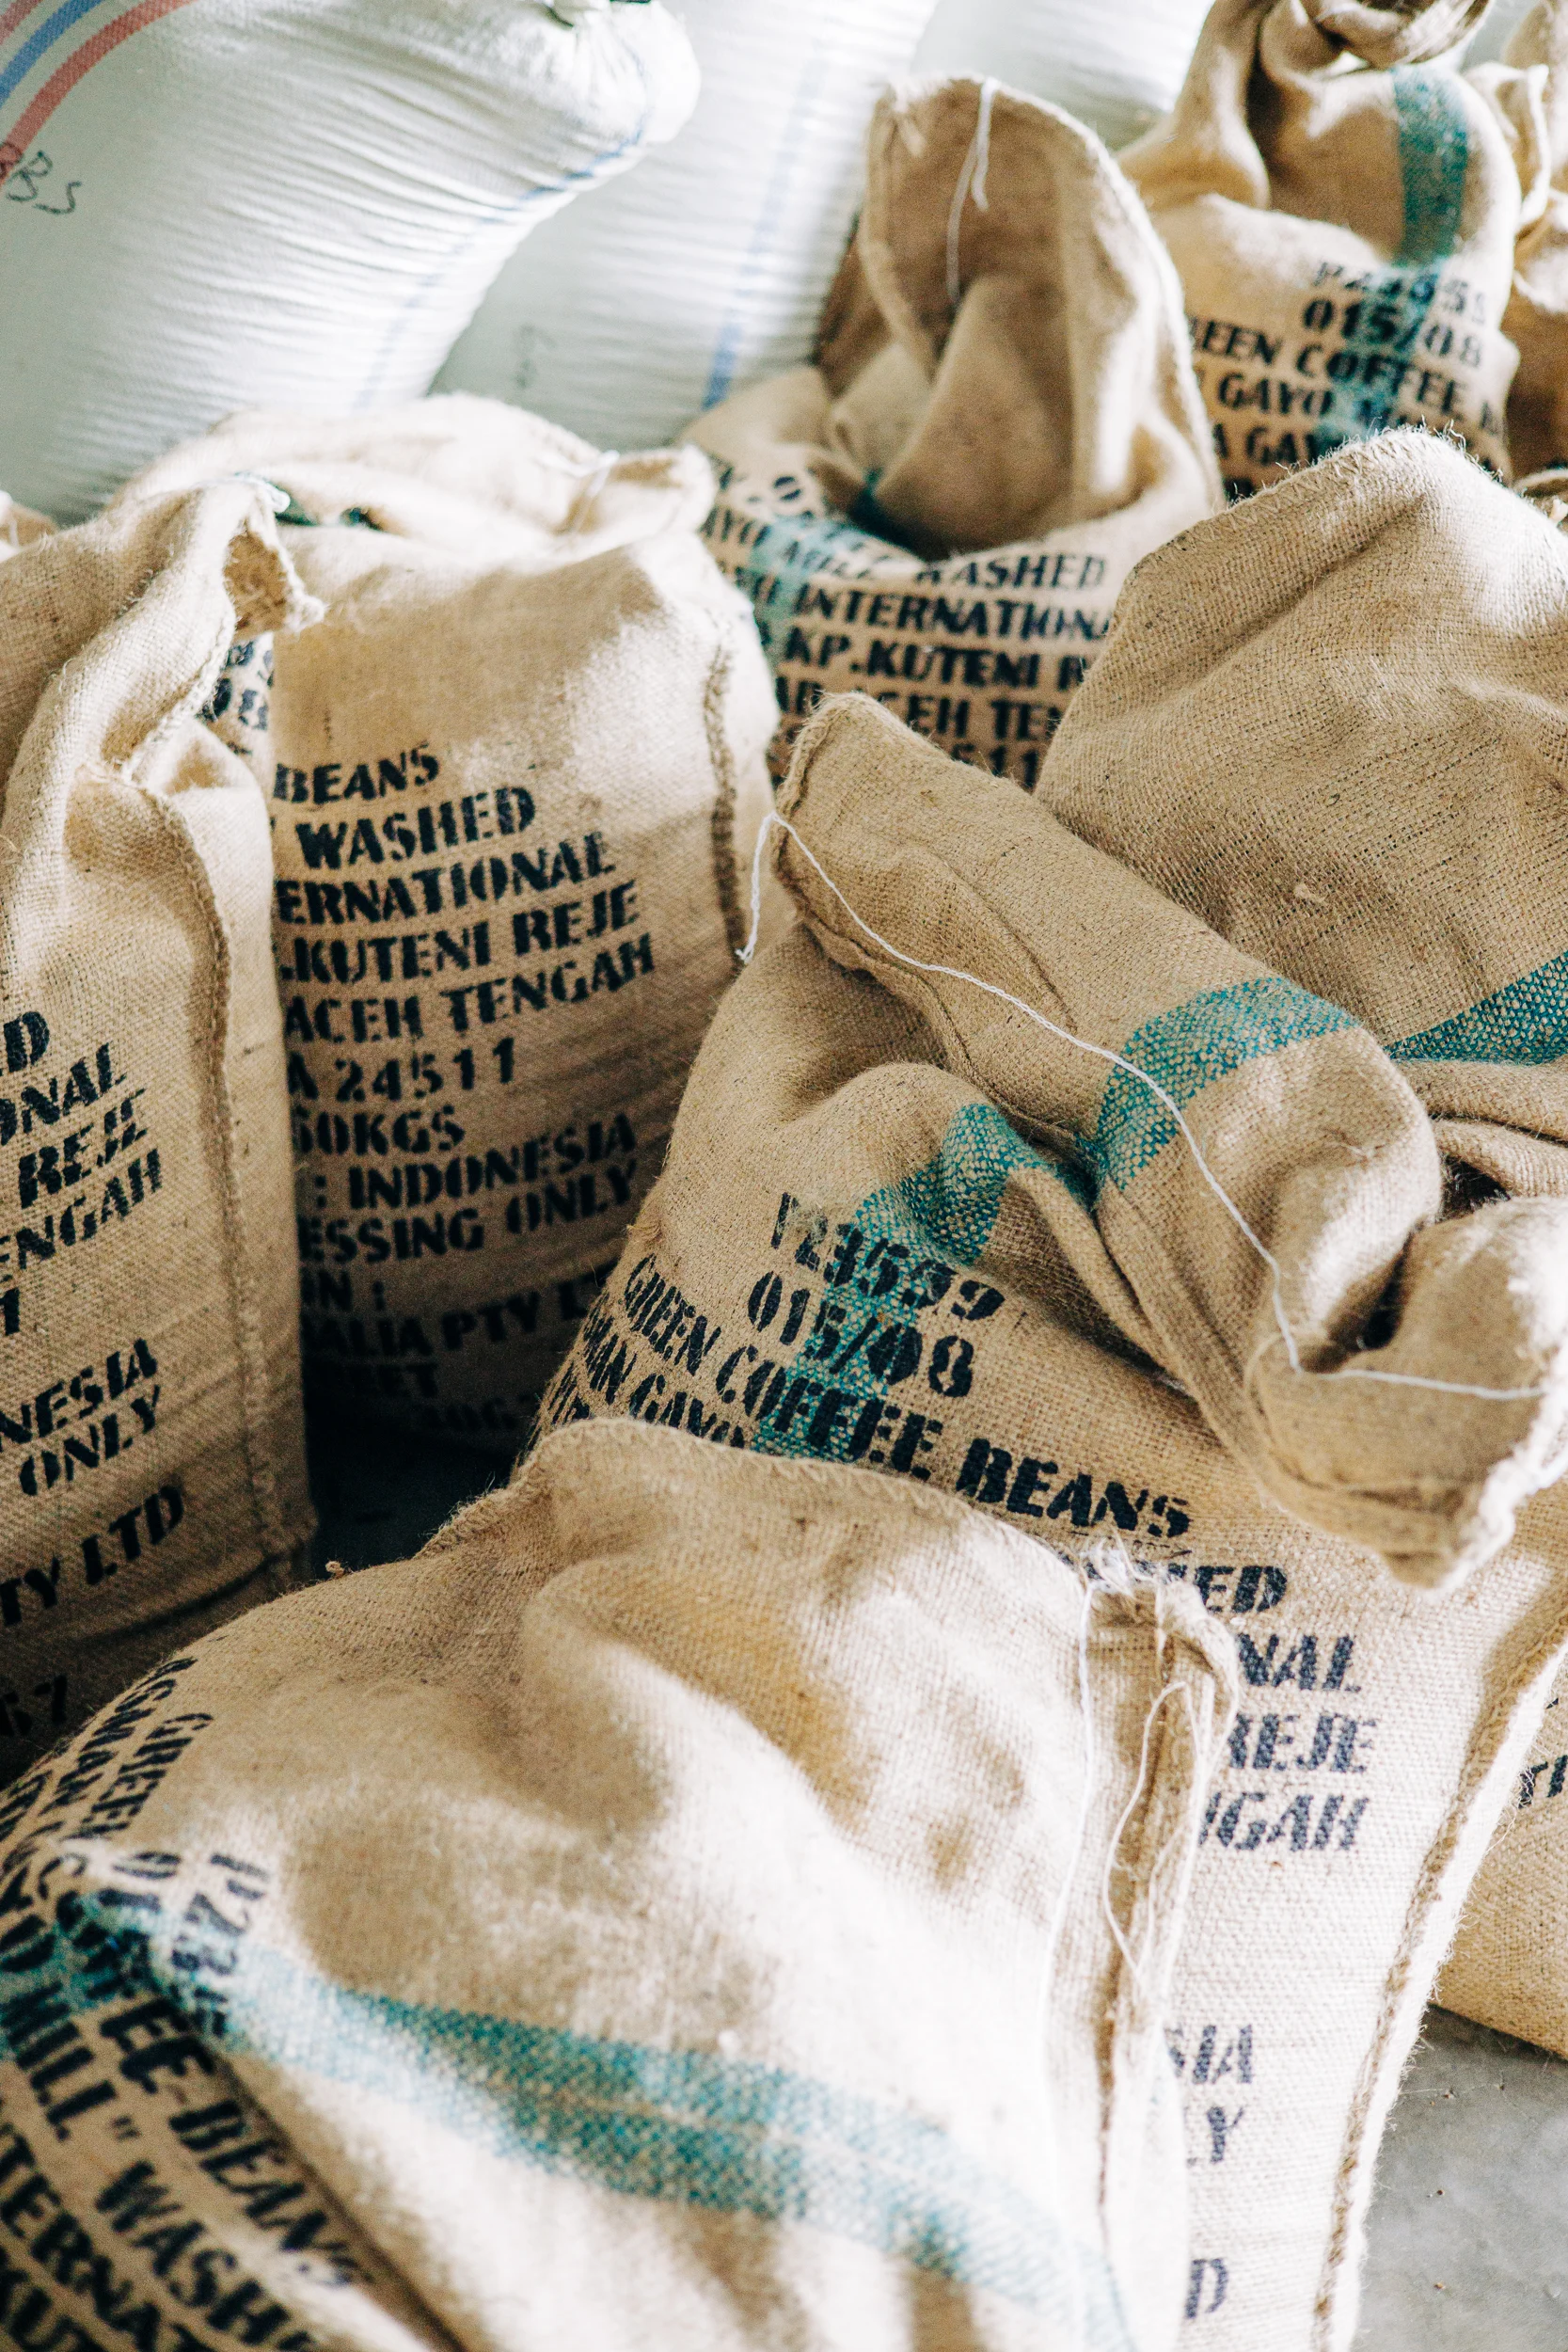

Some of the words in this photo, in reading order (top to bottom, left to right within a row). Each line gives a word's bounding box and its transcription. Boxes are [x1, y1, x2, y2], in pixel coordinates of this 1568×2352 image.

[273, 740, 439, 804] BEANS
[295, 786, 536, 870] WASHED
[512, 879, 641, 956] REJE
[285, 995, 424, 1044] ACEH
[439, 932, 656, 1033] TENGAH
[0, 1011, 50, 1076] D
[19, 1088, 148, 1210] REJE
[348, 1113, 638, 1212] INDONESIA
[506, 1159, 638, 1235] ONLY
[747, 1270, 975, 1399] 015/08
[19, 1384, 161, 1496] ONLY
[625, 1252, 722, 1376] GREEN
[716, 1343, 944, 1484] COFFEE
[956, 1438, 1193, 1539] BEANS
[80, 1484, 184, 1586] LTD
